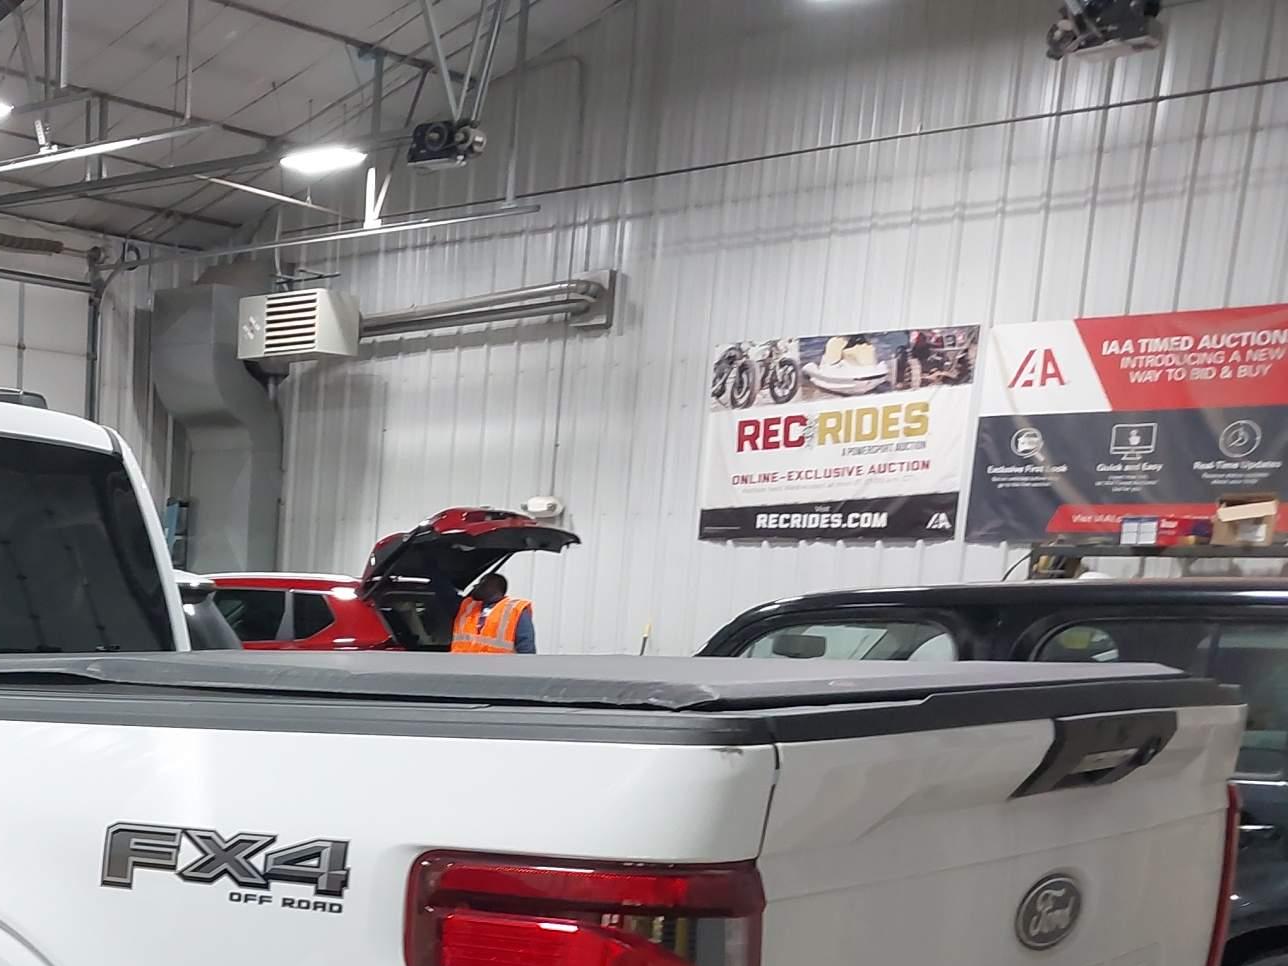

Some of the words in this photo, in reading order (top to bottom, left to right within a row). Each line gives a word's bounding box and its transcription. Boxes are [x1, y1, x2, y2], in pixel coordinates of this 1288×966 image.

[1102, 338, 1135, 355] IAA
[1137, 336, 1195, 353] TIMED
[1120, 350, 1225, 369] INTRODUCING
[1228, 350, 1241, 363] A
[1245, 347, 1287, 362] NEW
[1129, 369, 1163, 383] WAY
[1165, 367, 1187, 382] TO
[1190, 366, 1217, 380] BID
[1219, 365, 1233, 379] &
[1237, 363, 1273, 378] BUY
[736, 414, 808, 453] REC
[816, 401, 930, 446] RIDES
[732, 465, 863, 486] ONLINE-EXCLUSIVE
[867, 460, 931, 475] AUCTION
[756, 512, 889, 530] RECRIDES.COM
[101, 821, 351, 898] FX4
[228, 892, 273, 905] OFF
[281, 897, 344, 914] ROAD
